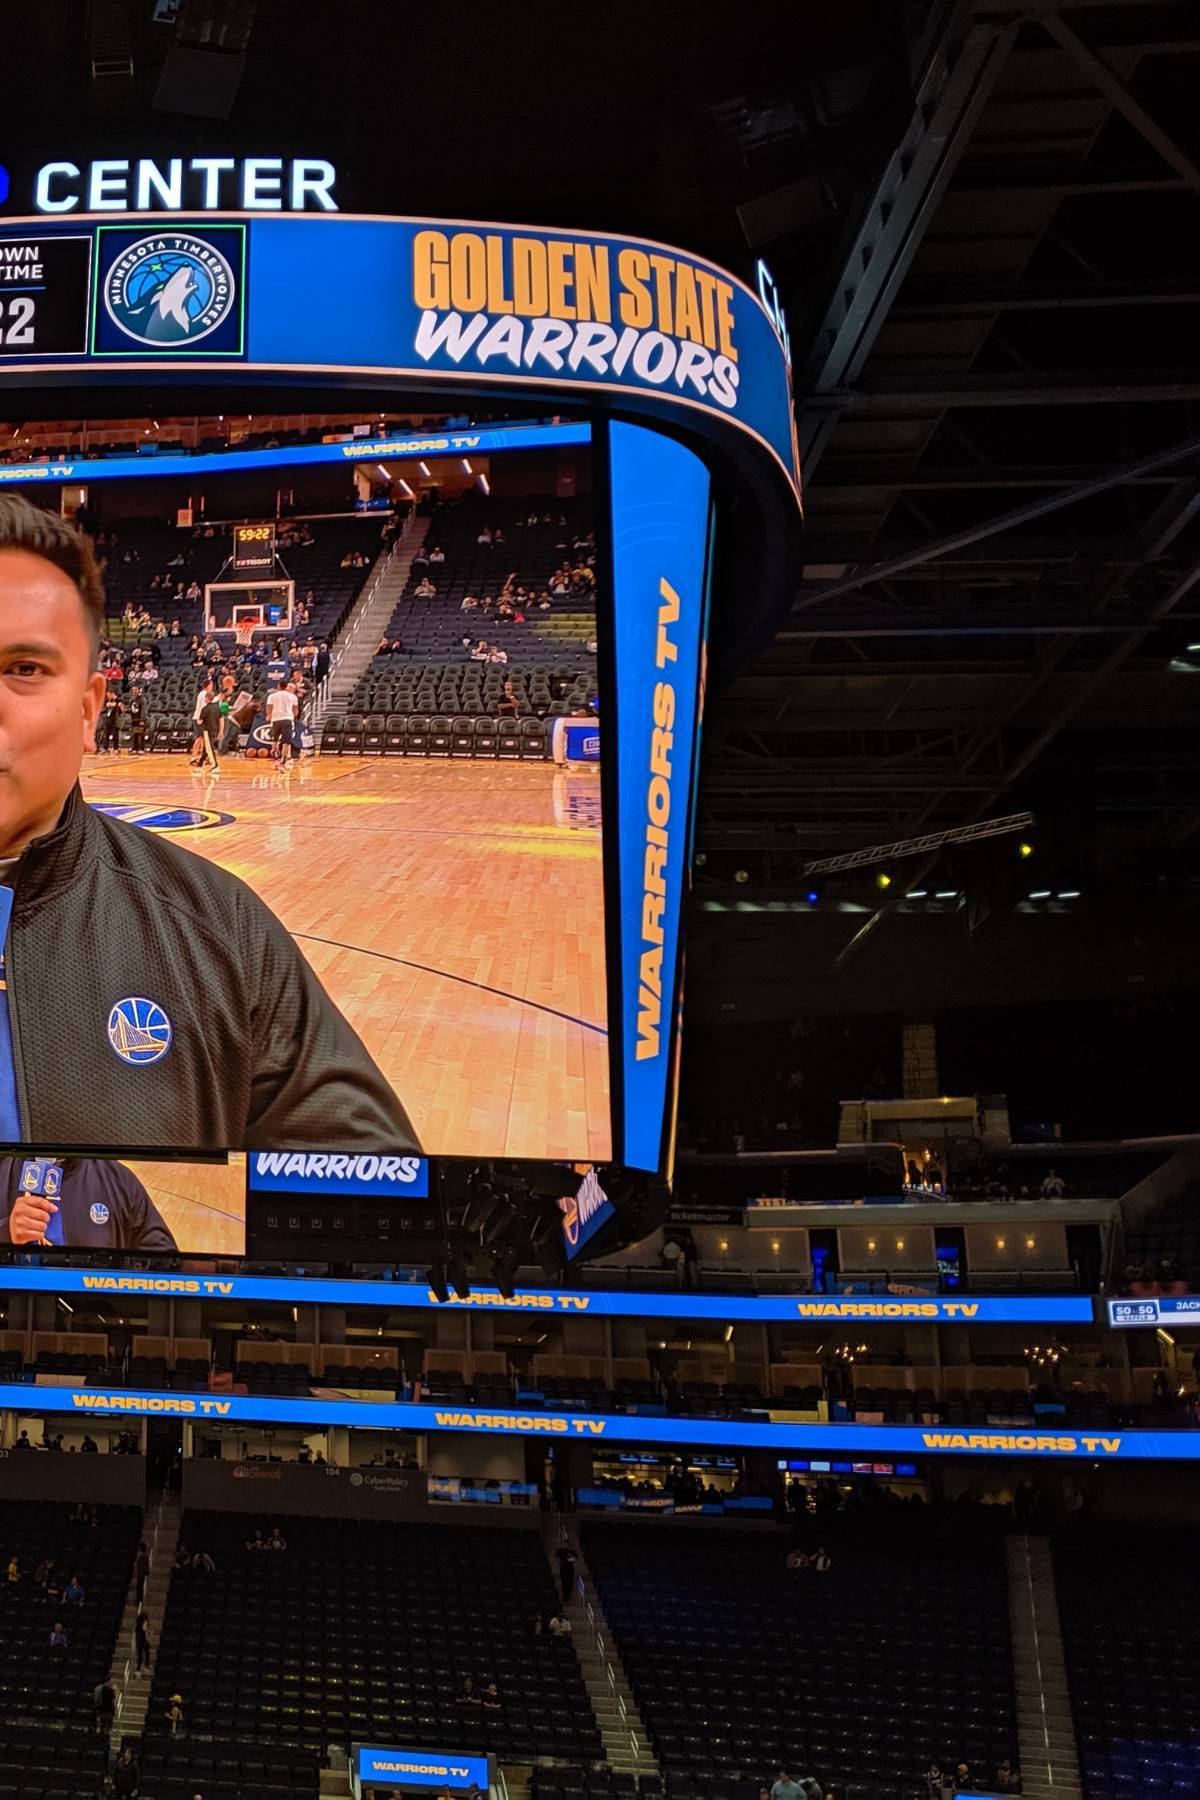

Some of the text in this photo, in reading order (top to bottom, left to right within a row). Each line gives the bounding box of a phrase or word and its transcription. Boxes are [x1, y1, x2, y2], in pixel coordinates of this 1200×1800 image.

[35, 157, 340, 212] CENTER
[111, 239, 228, 326] MINNESOTA TIMBERWOLVES
[412, 230, 739, 364] GOLDEN STATE
[413, 309, 740, 409] WARRIORS
[342, 435, 481, 457] WARRIORS TV
[51, 466, 74, 476] TV
[636, 576, 681, 1063] WARRIORS TV
[256, 1152, 421, 1184] WARRIORS
[82, 1275, 234, 1295] WARRIORS TV
[557, 1296, 590, 1310] TV
[797, 1303, 979, 1318] WARRIORS TV
[1115, 1305, 1154, 1315] 50 50
[71, 1394, 231, 1416] WARRIORS TV
[435, 1412, 605, 1434] WARRIORS TV
[922, 1433, 1120, 1453] WARRIORS TV
[372, 1761, 469, 1777] WARRIORS TV
